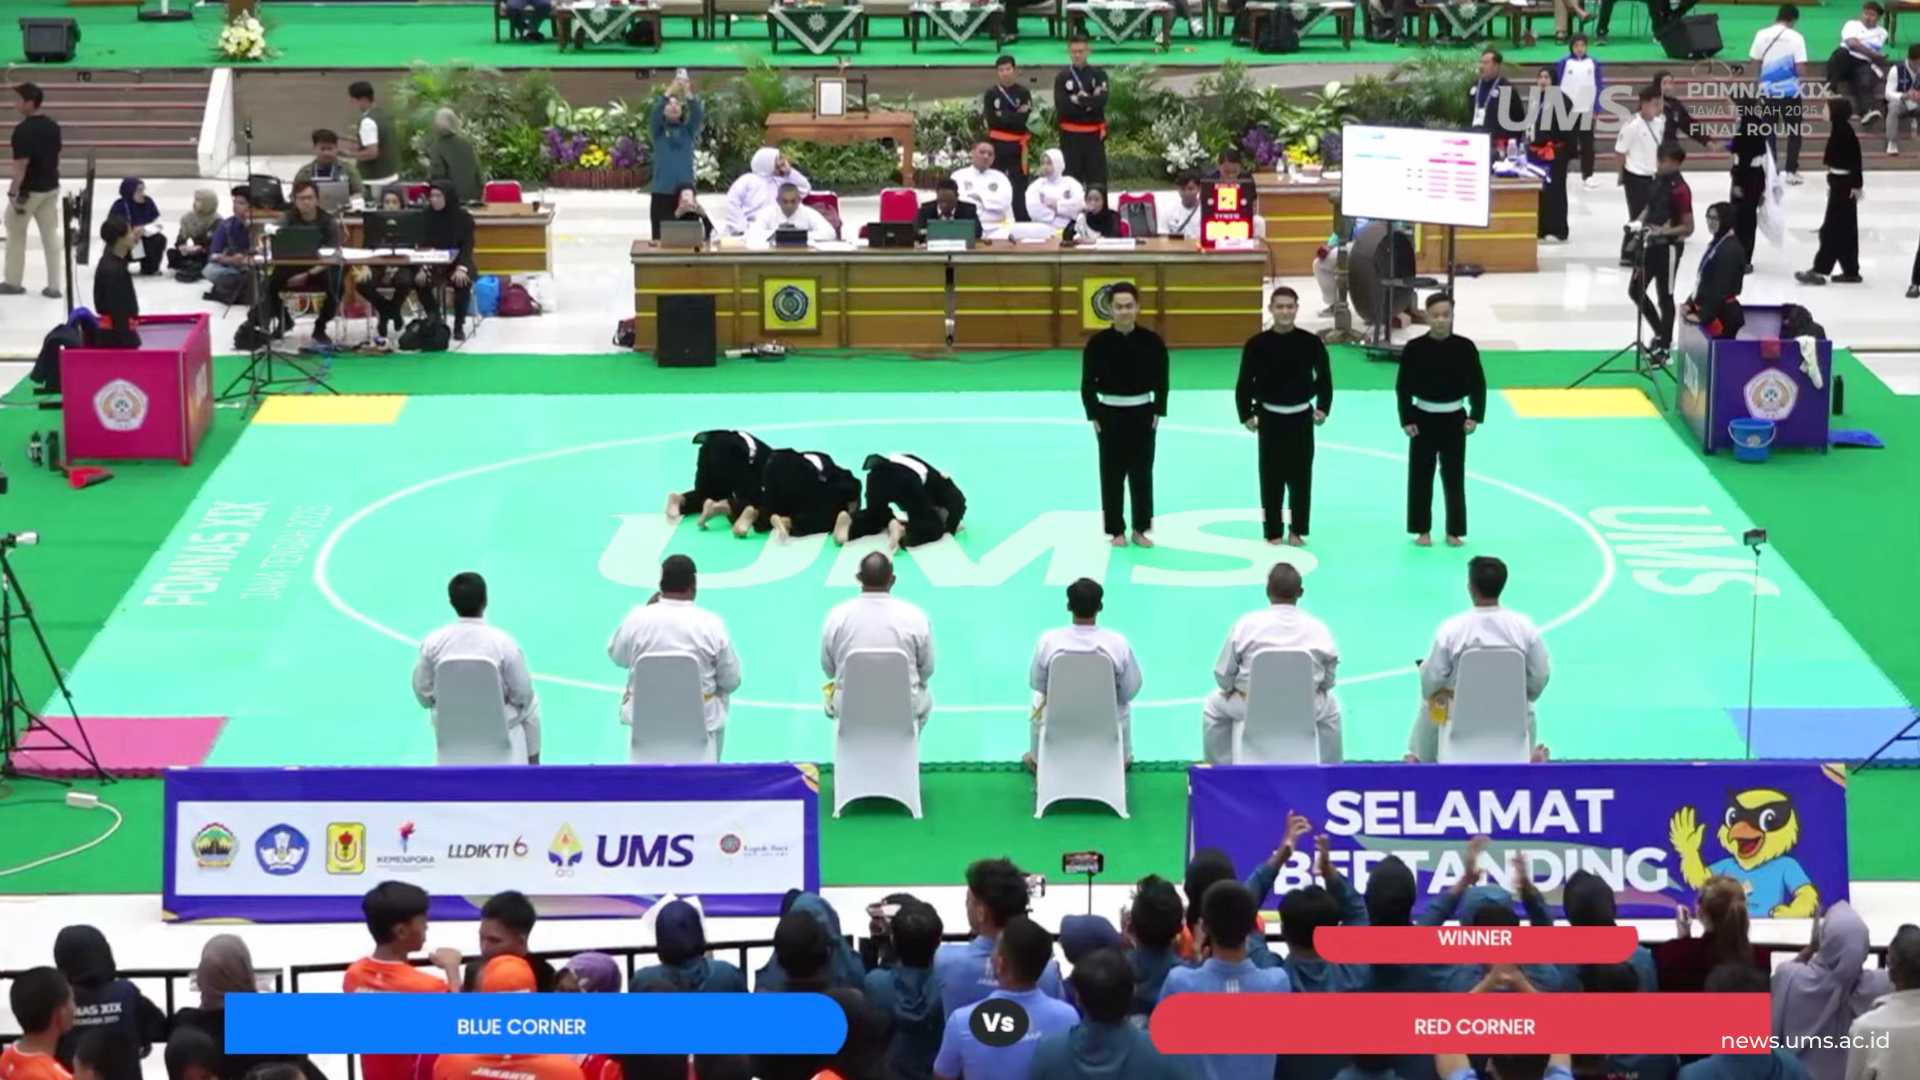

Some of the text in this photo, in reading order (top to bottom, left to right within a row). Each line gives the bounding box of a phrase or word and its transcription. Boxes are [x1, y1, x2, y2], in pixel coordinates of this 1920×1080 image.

[597, 508, 1320, 590] UMS
[1588, 504, 1781, 598] UMS
[1324, 788, 1615, 836] SELAMAT
[448, 834, 529, 860] LLDIKTI 6
[596, 834, 695, 868] UMS
